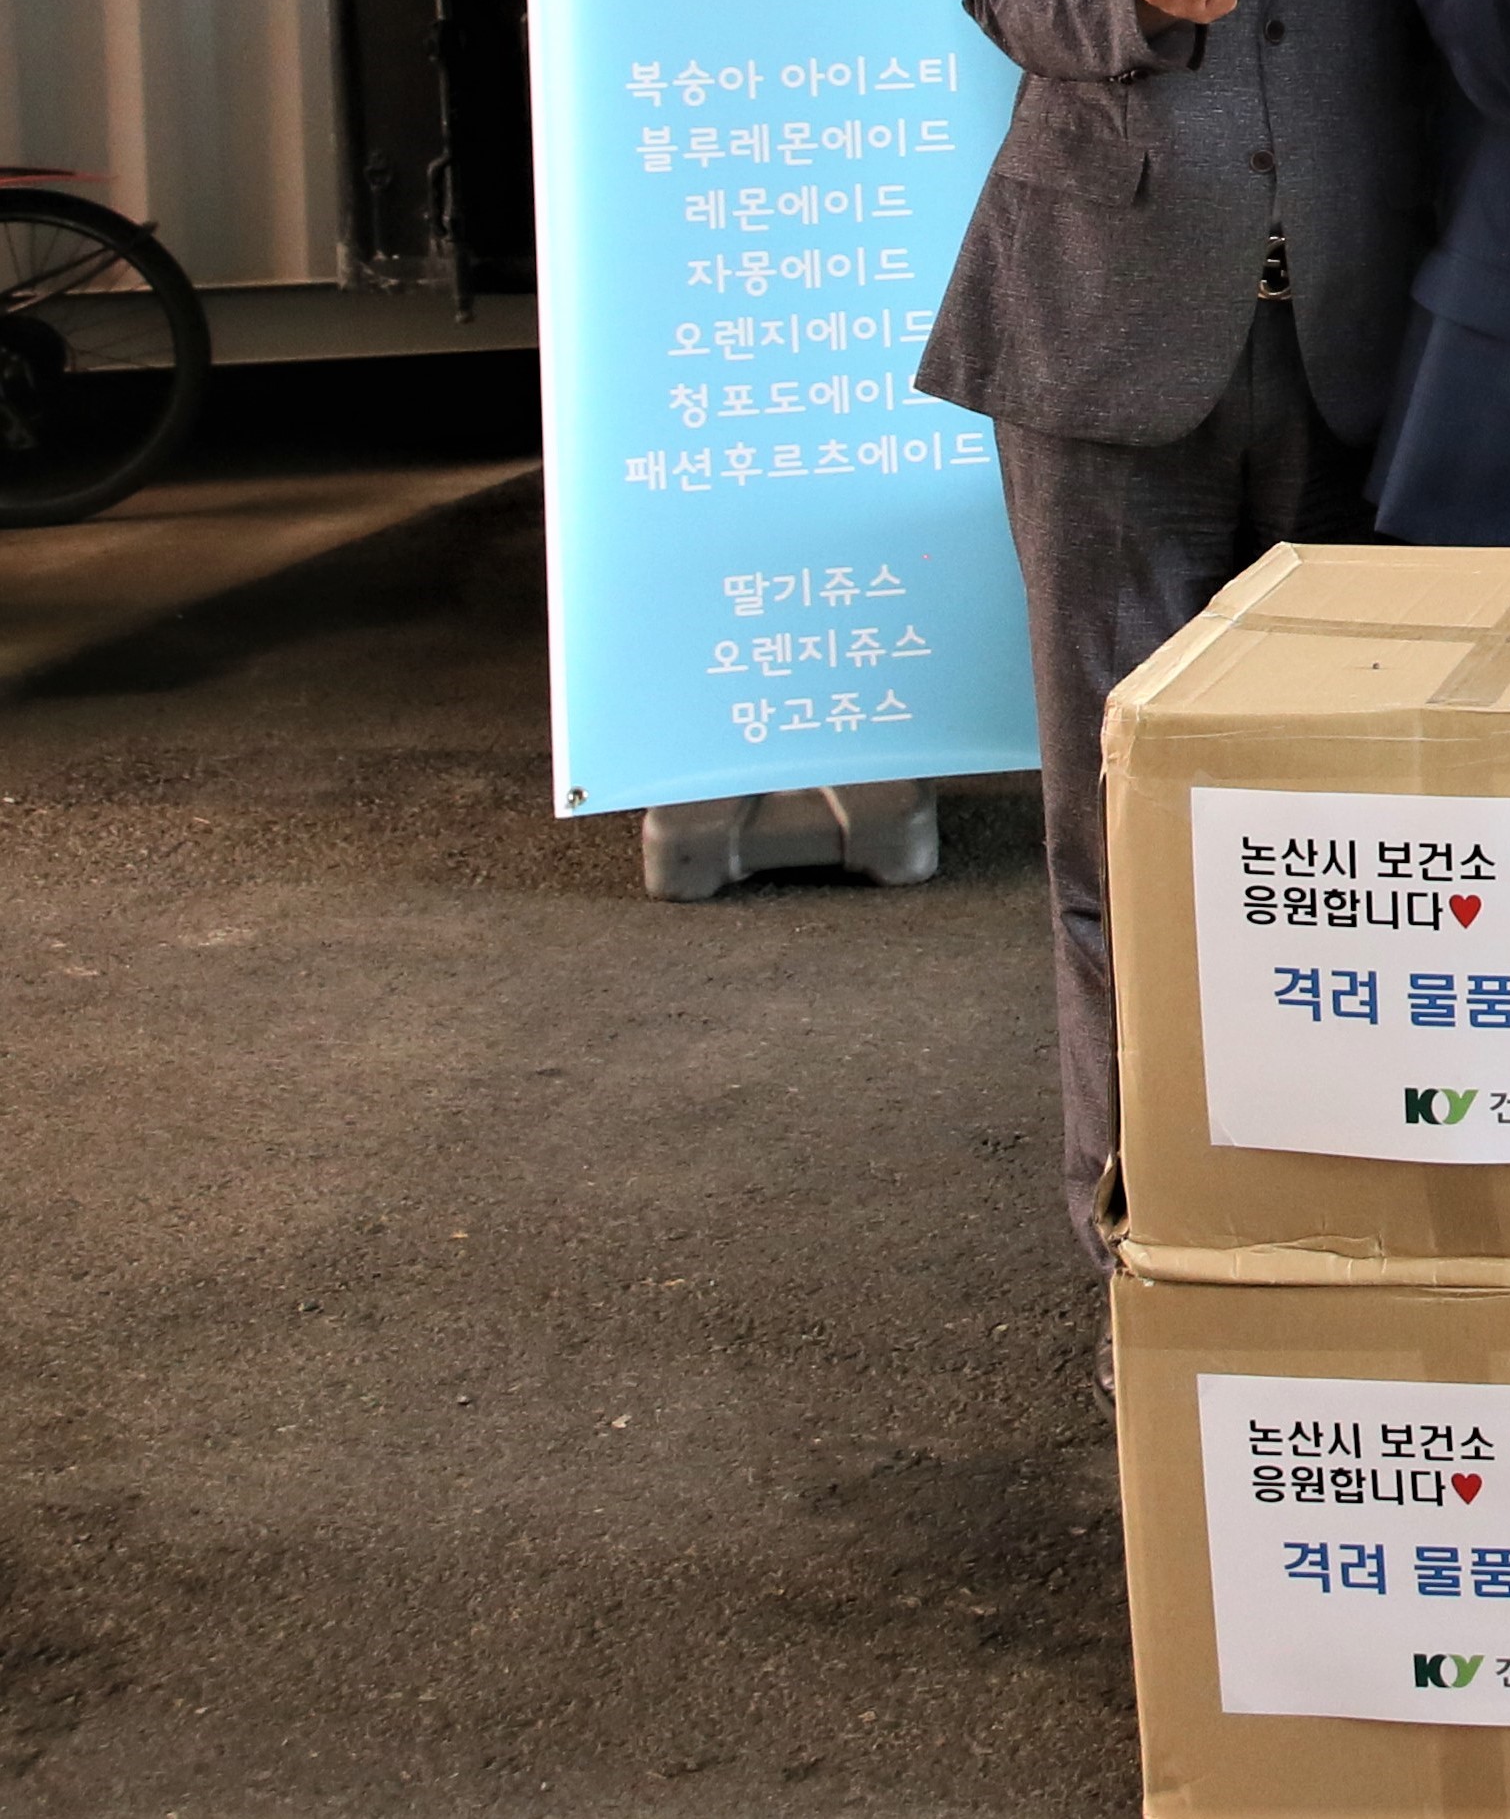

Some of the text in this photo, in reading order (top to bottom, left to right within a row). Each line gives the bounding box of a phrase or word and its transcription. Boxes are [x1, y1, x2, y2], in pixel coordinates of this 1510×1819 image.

[626, 53, 956, 112] 복숭아 아이스티
[636, 118, 955, 172] 블루레몬에이드
[686, 184, 913, 231] 레몬에이드
[688, 247, 915, 296] 자몽에이드
[668, 309, 933, 362] 오렌지에이드
[624, 431, 990, 493] 패션후르츠에이드
[724, 564, 907, 617] 딸기쥬스
[707, 627, 932, 678] 오렌지쥬스
[731, 689, 912, 745] 망고쥬스
[1242, 837, 1356, 879] 논산시
[1378, 842, 1495, 881] 보건소
[1244, 885, 1443, 931] 응원합니다
[1274, 967, 1378, 1025] 격려
[1249, 1420, 1361, 1458] 논산시
[1382, 1424, 1495, 1461] 보건소
[1253, 1466, 1446, 1506] 응원합니다
[1284, 1542, 1386, 1595] 격려
